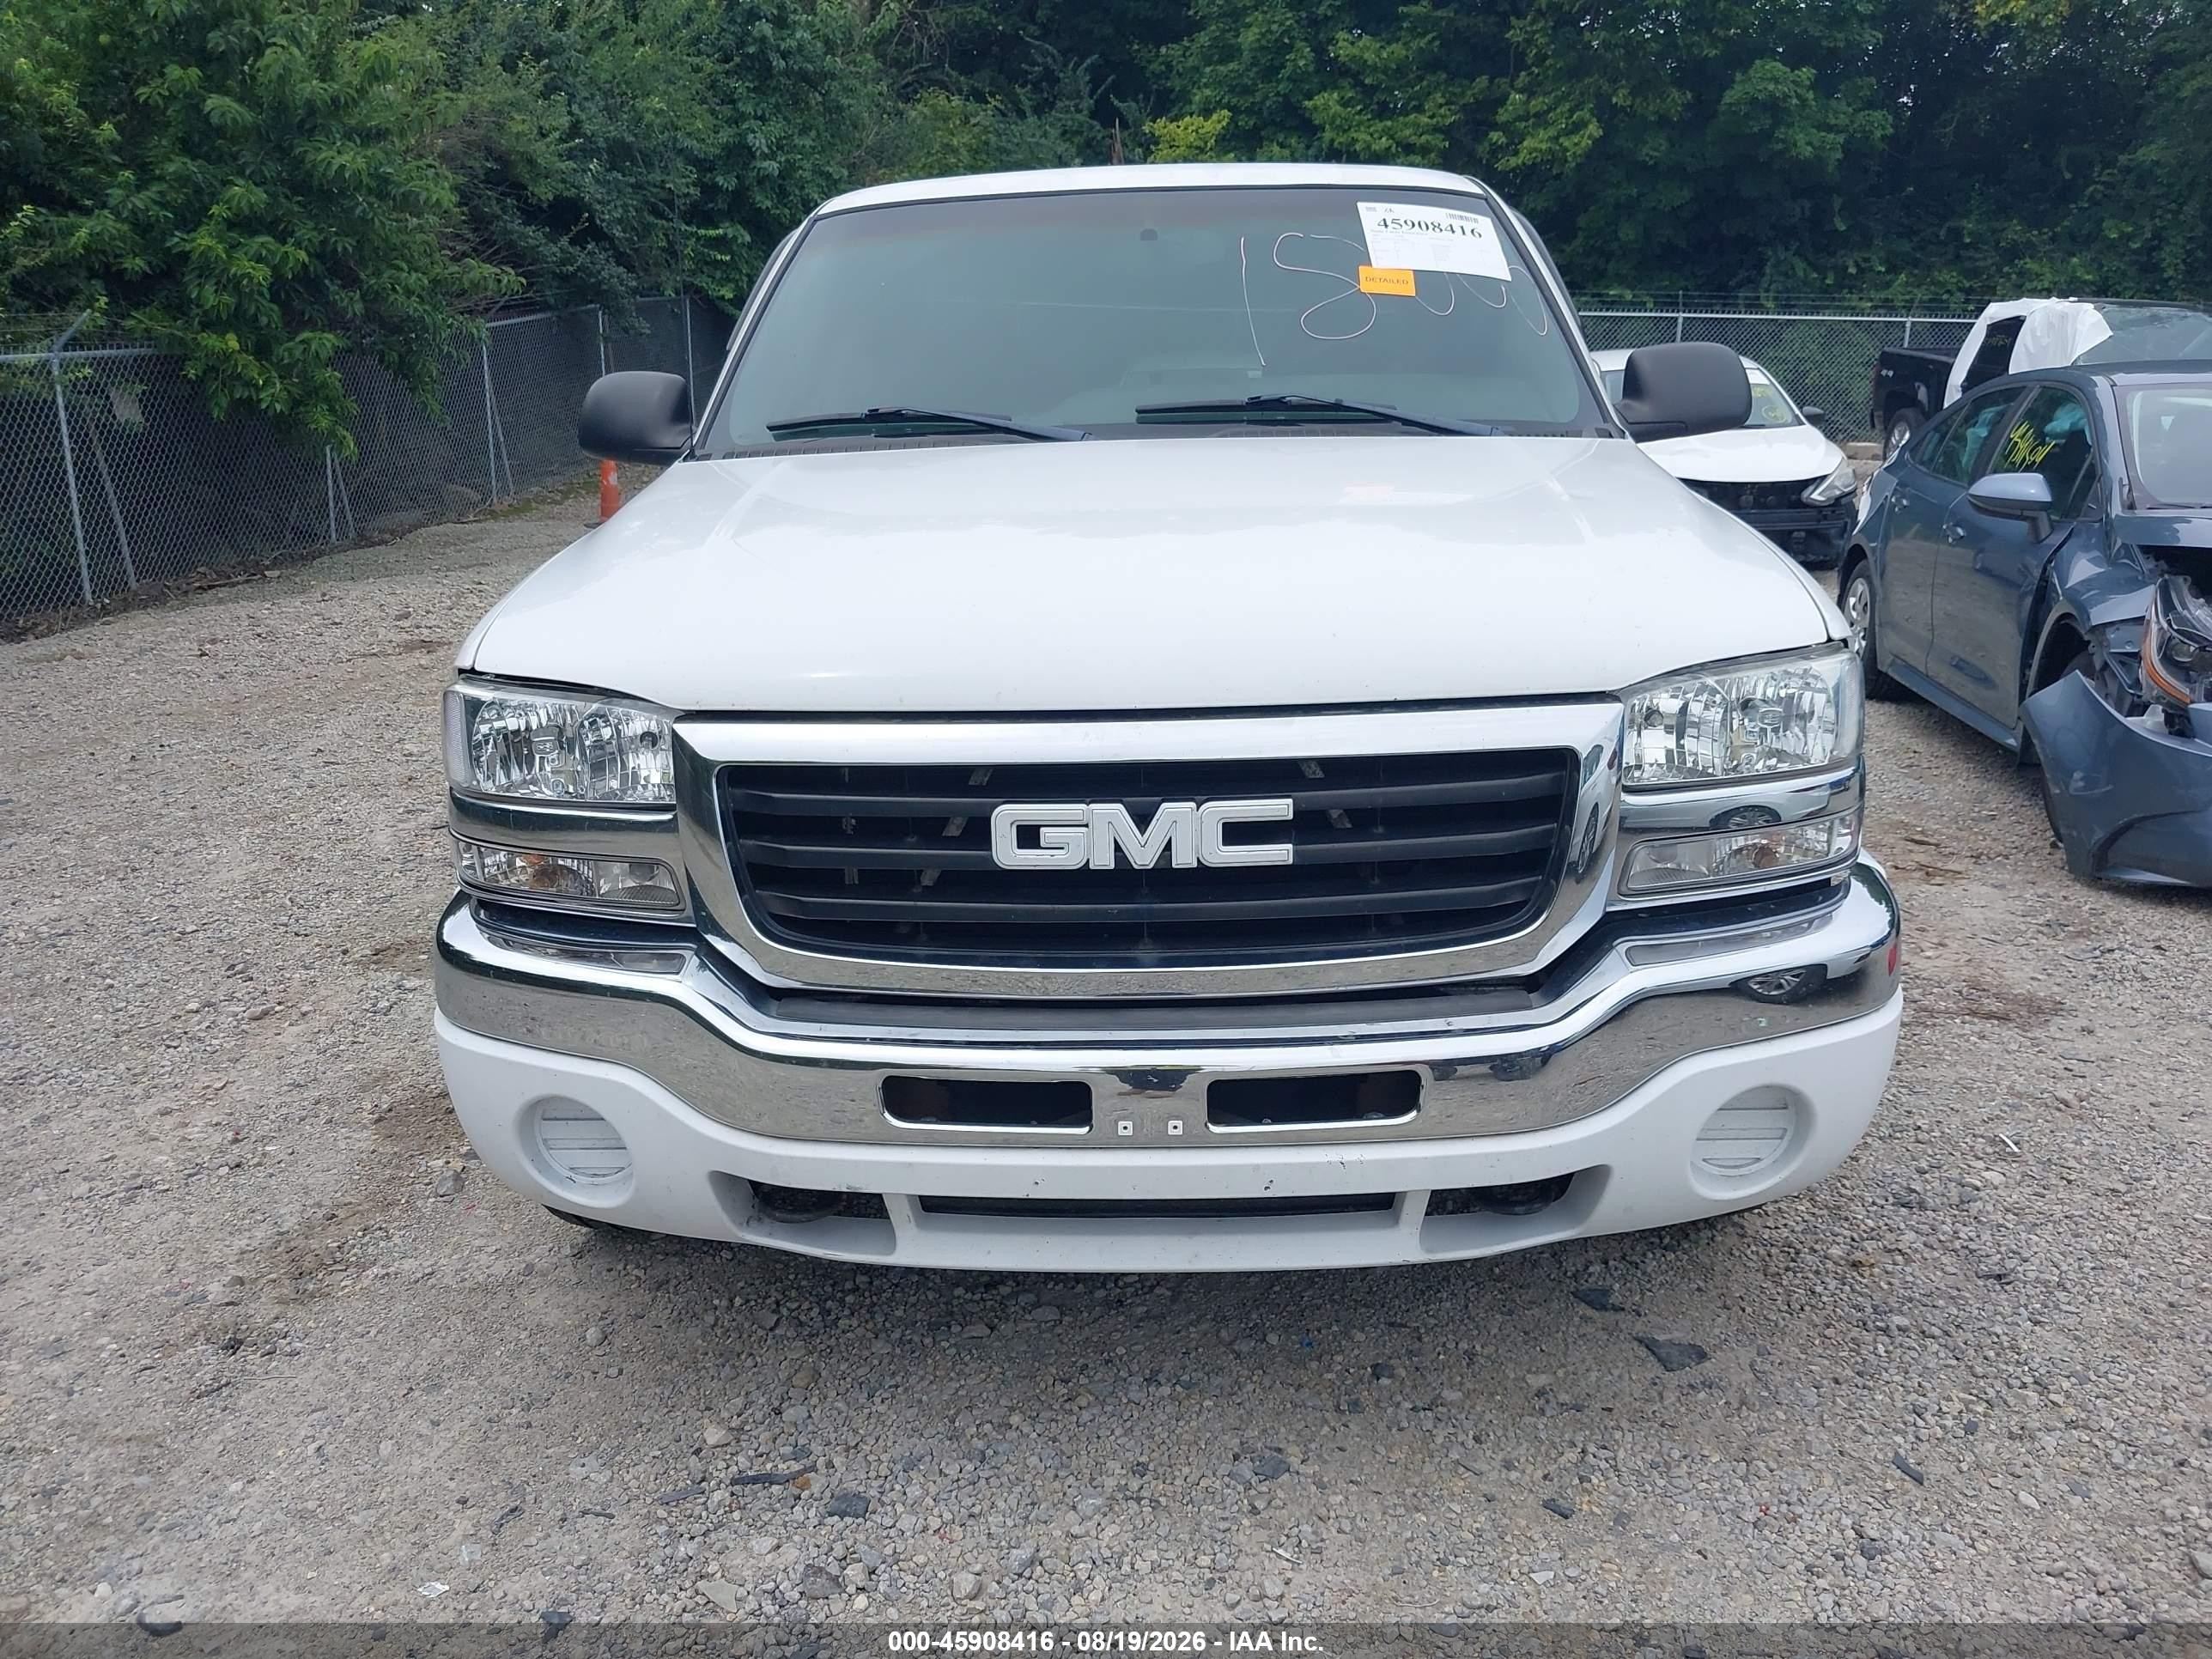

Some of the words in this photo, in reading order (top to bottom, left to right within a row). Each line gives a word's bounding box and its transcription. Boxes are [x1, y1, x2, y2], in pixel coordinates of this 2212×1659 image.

[1377, 217, 1483, 240] 45908416
[1365, 276, 1409, 286] DETAILED
[991, 799, 1294, 870] GMC
